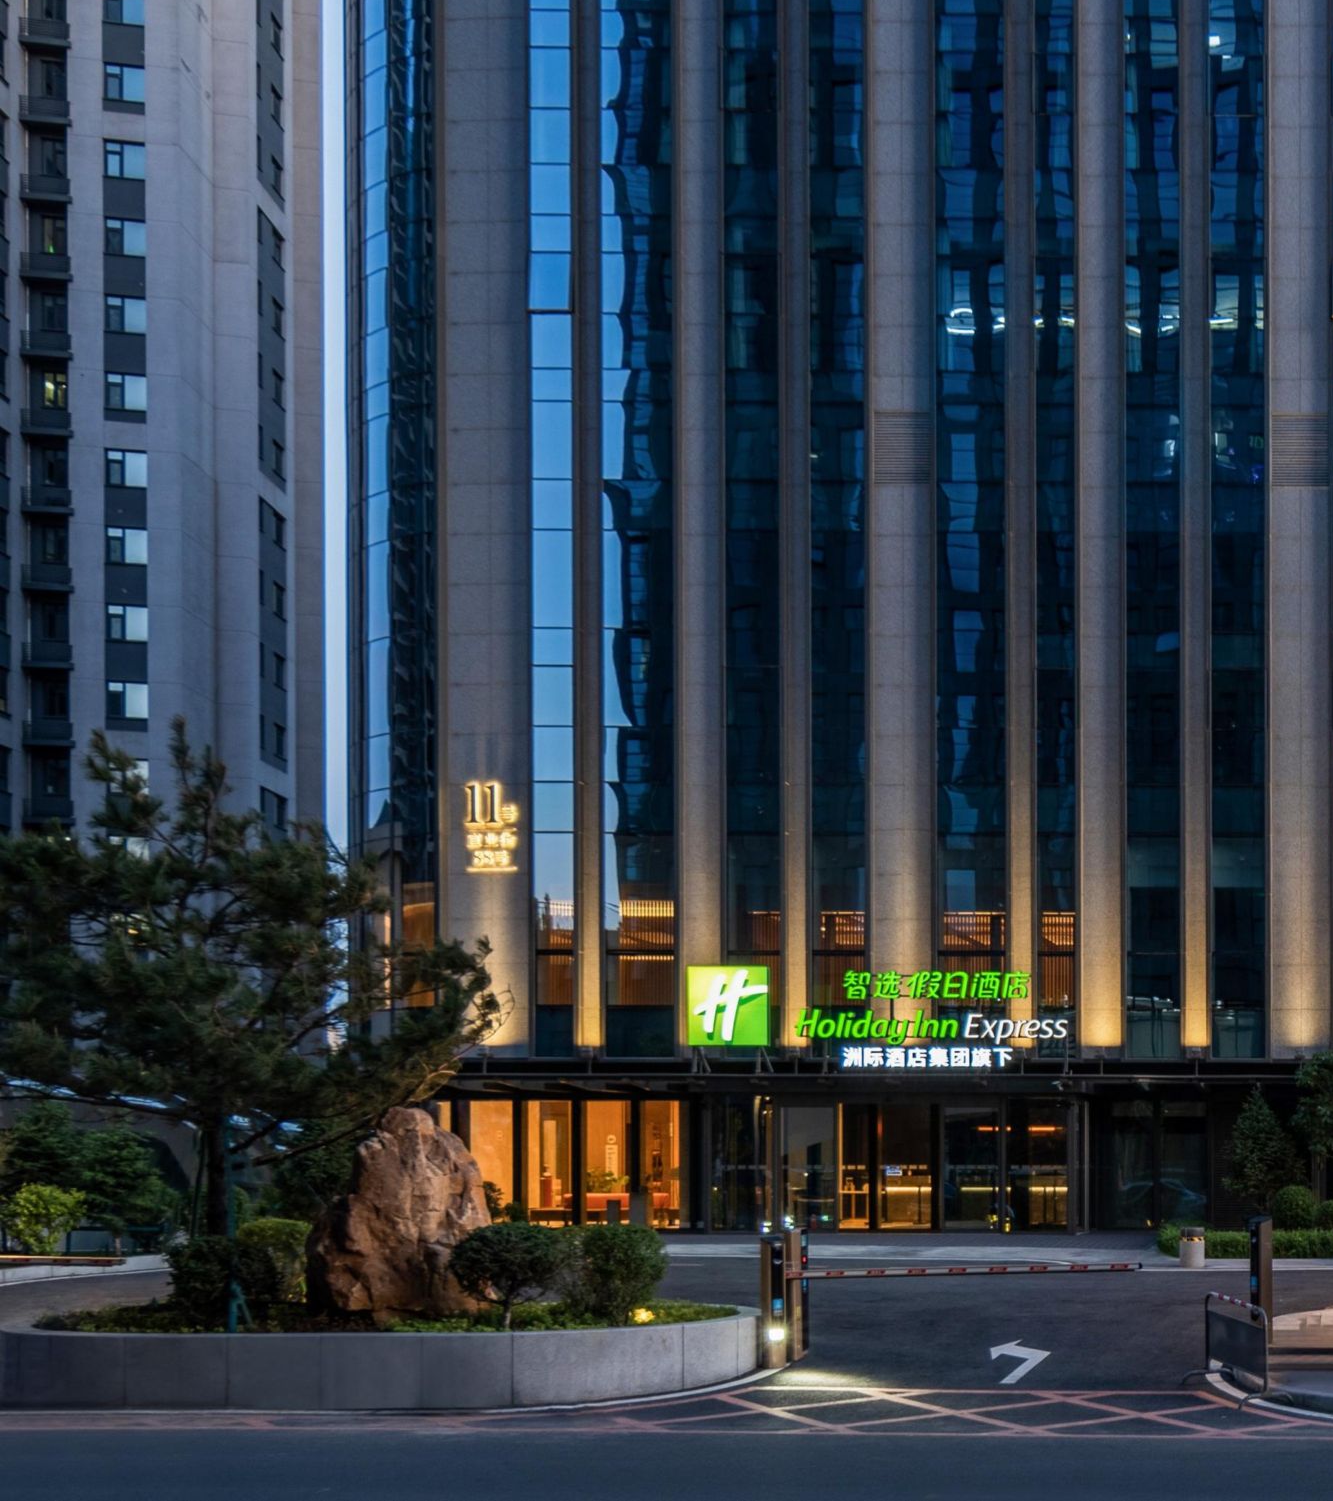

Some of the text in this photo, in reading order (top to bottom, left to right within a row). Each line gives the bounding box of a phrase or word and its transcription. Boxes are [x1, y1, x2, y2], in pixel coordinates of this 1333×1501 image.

[843, 970, 1031, 1000] 智选假日酒店
[795, 1009, 1069, 1045] Holiday Inn Express
[842, 1047, 1013, 1068] 洲际酒店集团旗下
